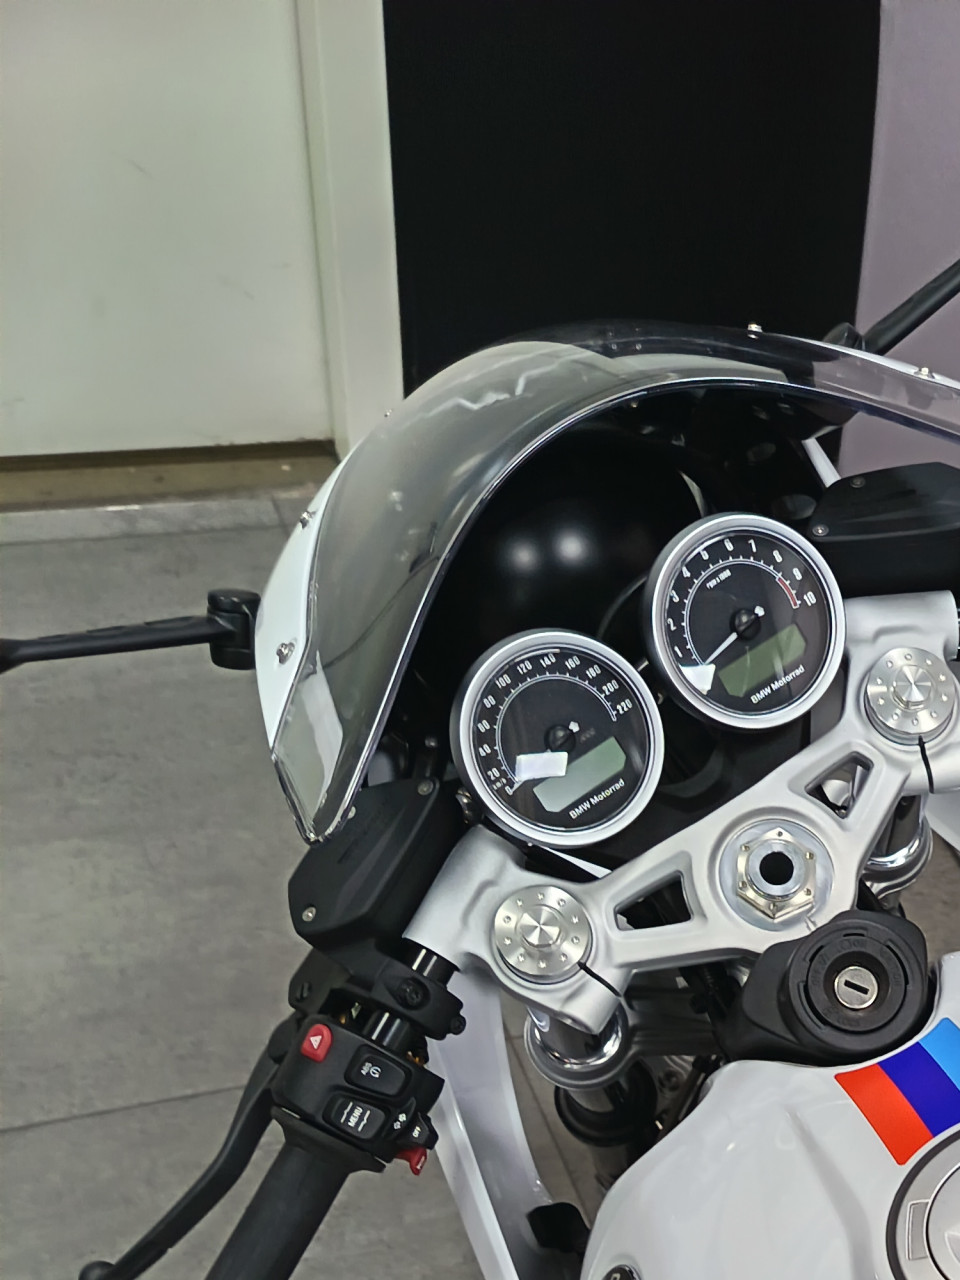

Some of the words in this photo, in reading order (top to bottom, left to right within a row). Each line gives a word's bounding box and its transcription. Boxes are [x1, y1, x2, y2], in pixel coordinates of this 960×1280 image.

[748, 539, 757, 552] 7
[681, 566, 691, 578] 4
[803, 591, 817, 607] 10
[667, 618, 677, 631] 2
[674, 646, 683, 658] 1
[516, 660, 533, 675] 120
[539, 653, 556, 668] 140
[564, 656, 581, 671] 160
[585, 664, 602, 680] 180
[495, 674, 511, 689] 100
[602, 680, 619, 696] 200
[750, 686, 772, 705] BMW
[771, 665, 805, 692] Motorrad
[616, 699, 633, 715] 220
[478, 743, 491, 757] 40
[487, 767, 500, 781] 20
[568, 800, 591, 820] BMW
[591, 778, 625, 805] Motorrad
[348, 1106, 363, 1128] MENU
